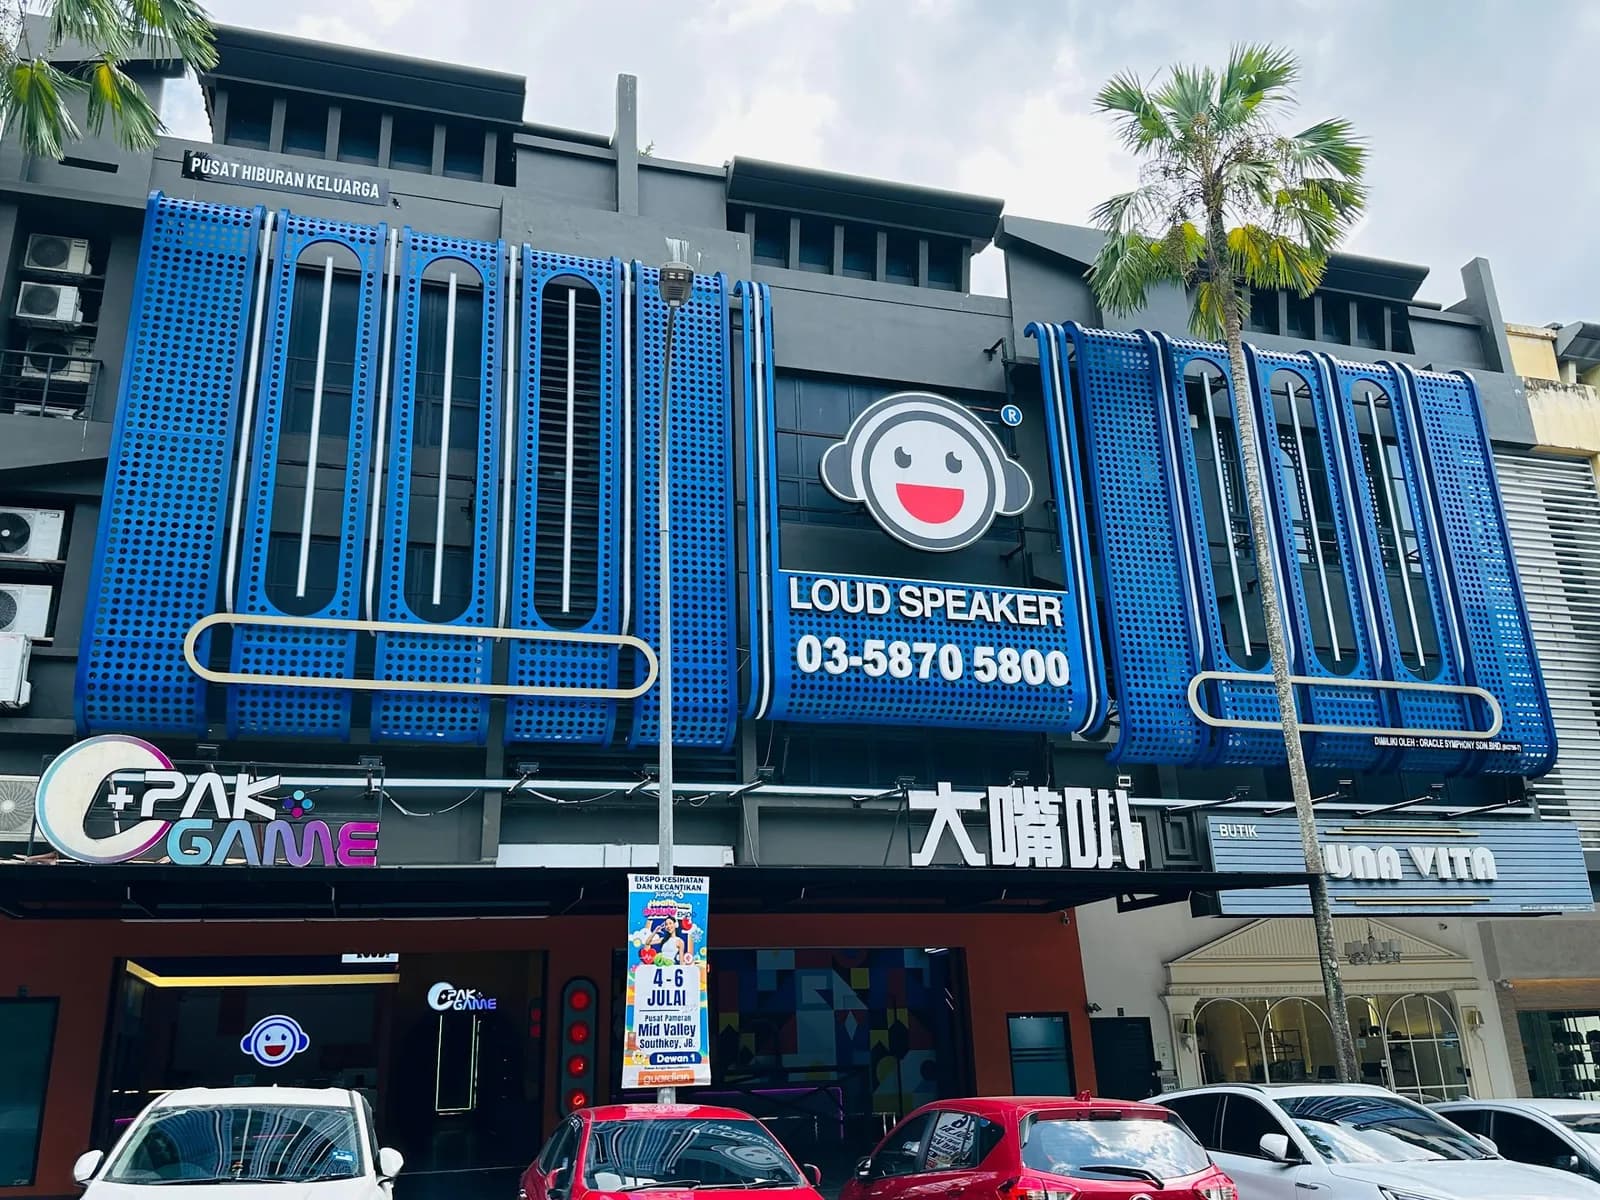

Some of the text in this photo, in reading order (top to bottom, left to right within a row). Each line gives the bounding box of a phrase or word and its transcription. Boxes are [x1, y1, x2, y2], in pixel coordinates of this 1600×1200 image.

[191, 158, 380, 198] PUSAT HIBURAN KELUARGA
[789, 577, 1063, 627] LOUD SPEAKER
[796, 634, 1070, 687] 03-5870 5800
[1399, 738, 1415, 747] OLEH
[1420, 739, 1444, 748] ORACLE
[908, 782, 1140, 870] 大嘴叭
[1219, 824, 1259, 838] BUTIK
[167, 819, 379, 867] GAME
[1322, 844, 1498, 880] UNA VITA
[662, 876, 704, 884] KESIHATAN
[453, 999, 496, 1011] GAME
[647, 990, 686, 1006] JULAI
[638, 1023, 696, 1037] Mid Valley
[657, 1054, 696, 1063] Dewan 1
[643, 1071, 690, 1084] guardian
